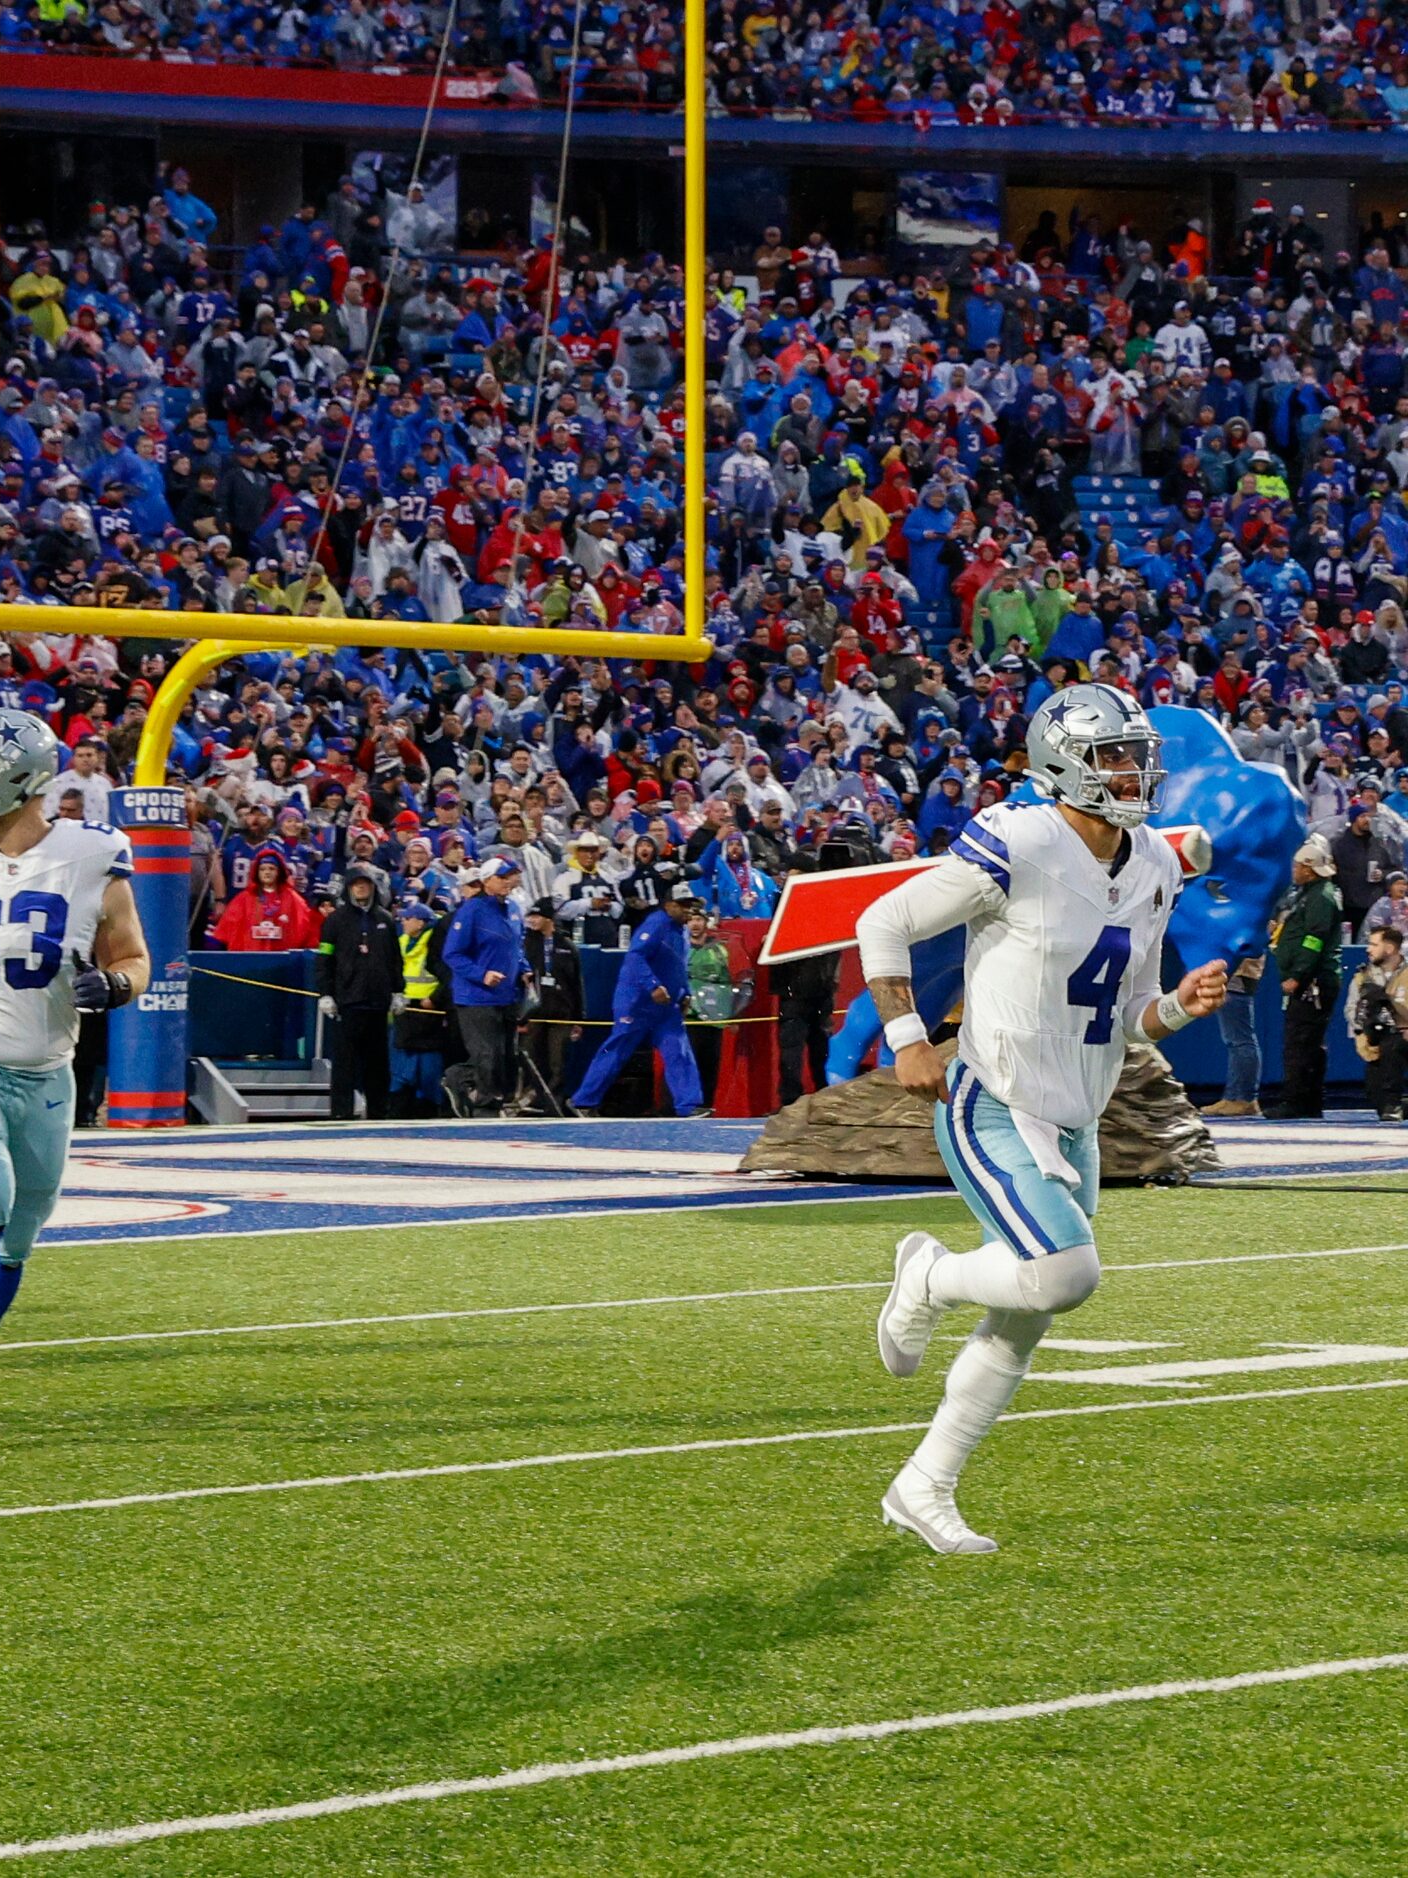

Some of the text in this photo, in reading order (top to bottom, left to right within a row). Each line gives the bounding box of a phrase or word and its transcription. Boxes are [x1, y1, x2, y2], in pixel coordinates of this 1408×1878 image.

[967, 433, 980, 451] 3
[399, 495, 427, 521] 27
[867, 614, 887, 634] 14
[135, 807, 180, 822] LOVE
[634, 878, 659, 906] 11
[1067, 925, 1132, 1045] 4
